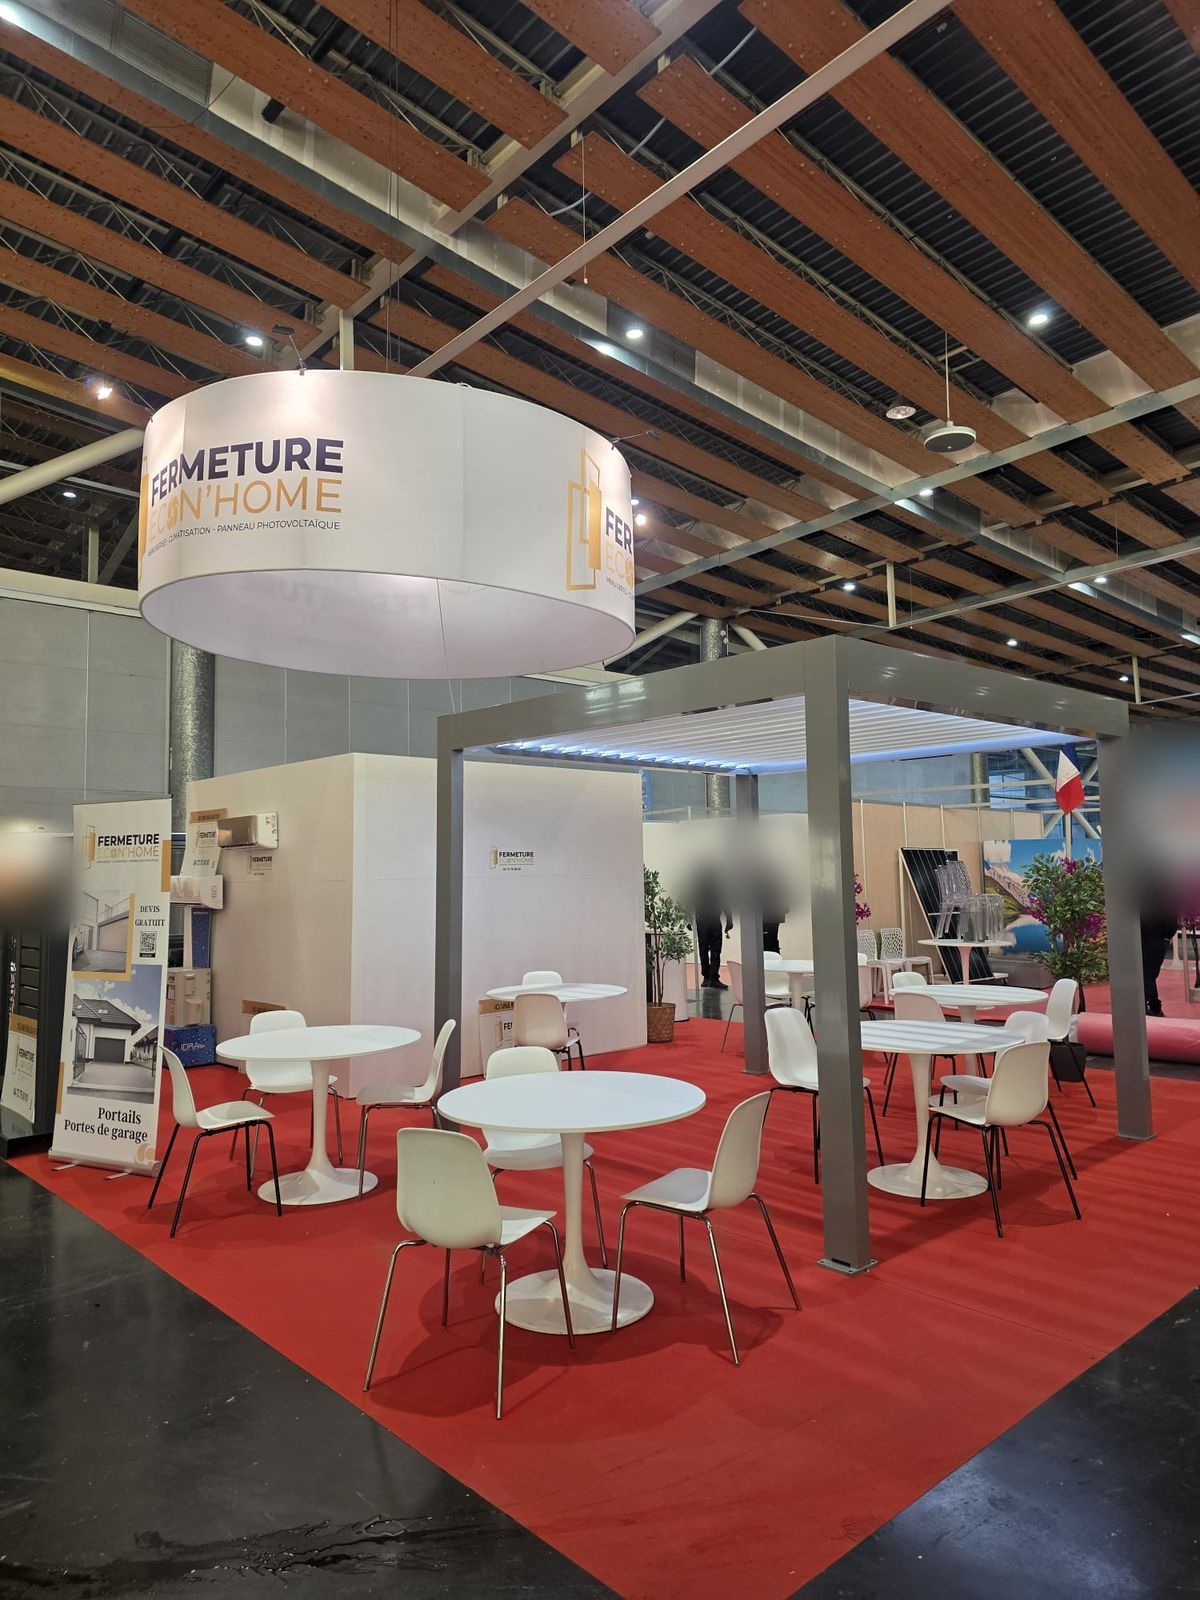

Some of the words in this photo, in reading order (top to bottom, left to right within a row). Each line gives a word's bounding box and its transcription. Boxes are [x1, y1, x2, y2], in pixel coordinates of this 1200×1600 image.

[151, 437, 344, 507] FERMETURE
[217, 522, 255, 532] PANNEAU
[257, 518, 341, 530] PHOTOVOLTAÏQUE
[97, 833, 160, 847] FERMETURE
[139, 905, 160, 913] DEVIS
[134, 918, 166, 927] GRATUIT
[97, 1107, 142, 1125] Portails
[64, 1119, 96, 1135] Portes
[97, 1123, 109, 1137] de
[111, 1127, 148, 1145] garage
